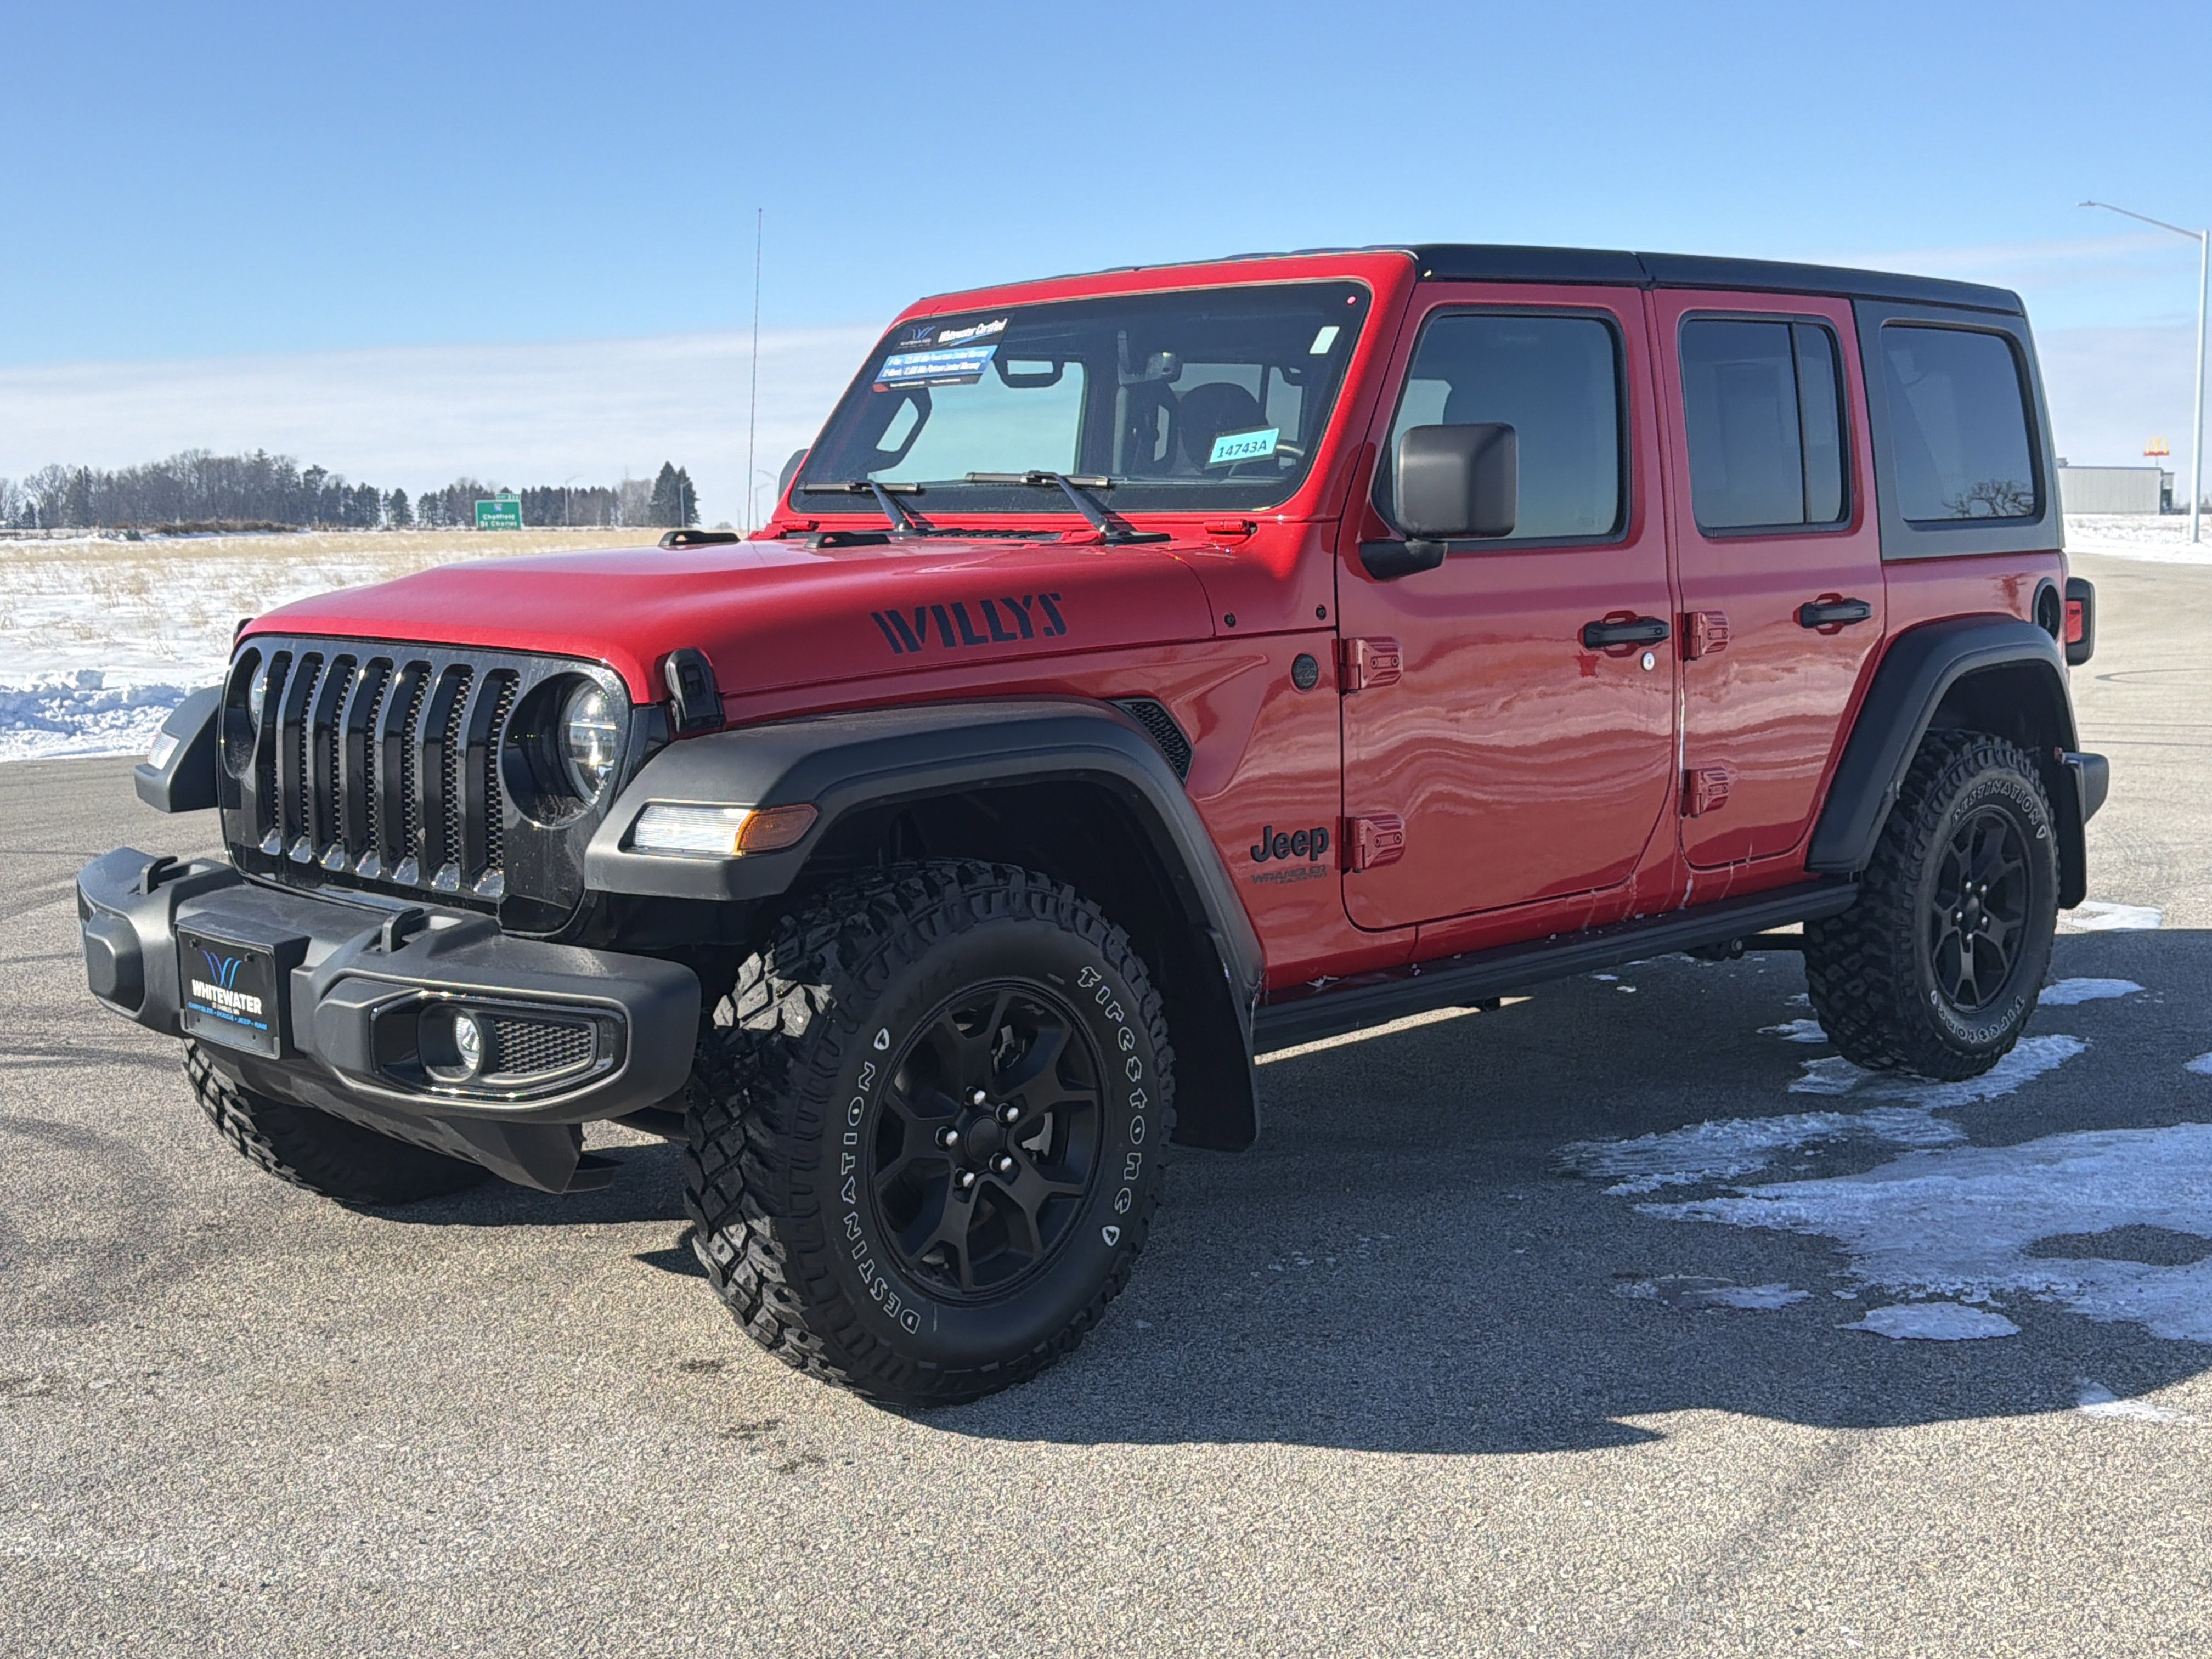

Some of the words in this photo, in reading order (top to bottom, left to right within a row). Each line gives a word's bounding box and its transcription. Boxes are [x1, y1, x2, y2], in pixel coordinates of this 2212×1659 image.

[975, 318, 1008, 335] Certified
[1217, 439, 1267, 458] 14743A
[870, 592, 1067, 654] WILLYS
[1951, 780, 2040, 825] DESTINATION
[1250, 825, 1329, 862] Jeep
[192, 979, 262, 1015] WHITEWATER
[237, 1017, 251, 1025] JEEP
[1077, 966, 1147, 1214] Firestone
[842, 1061, 921, 1335] DESTINATION
